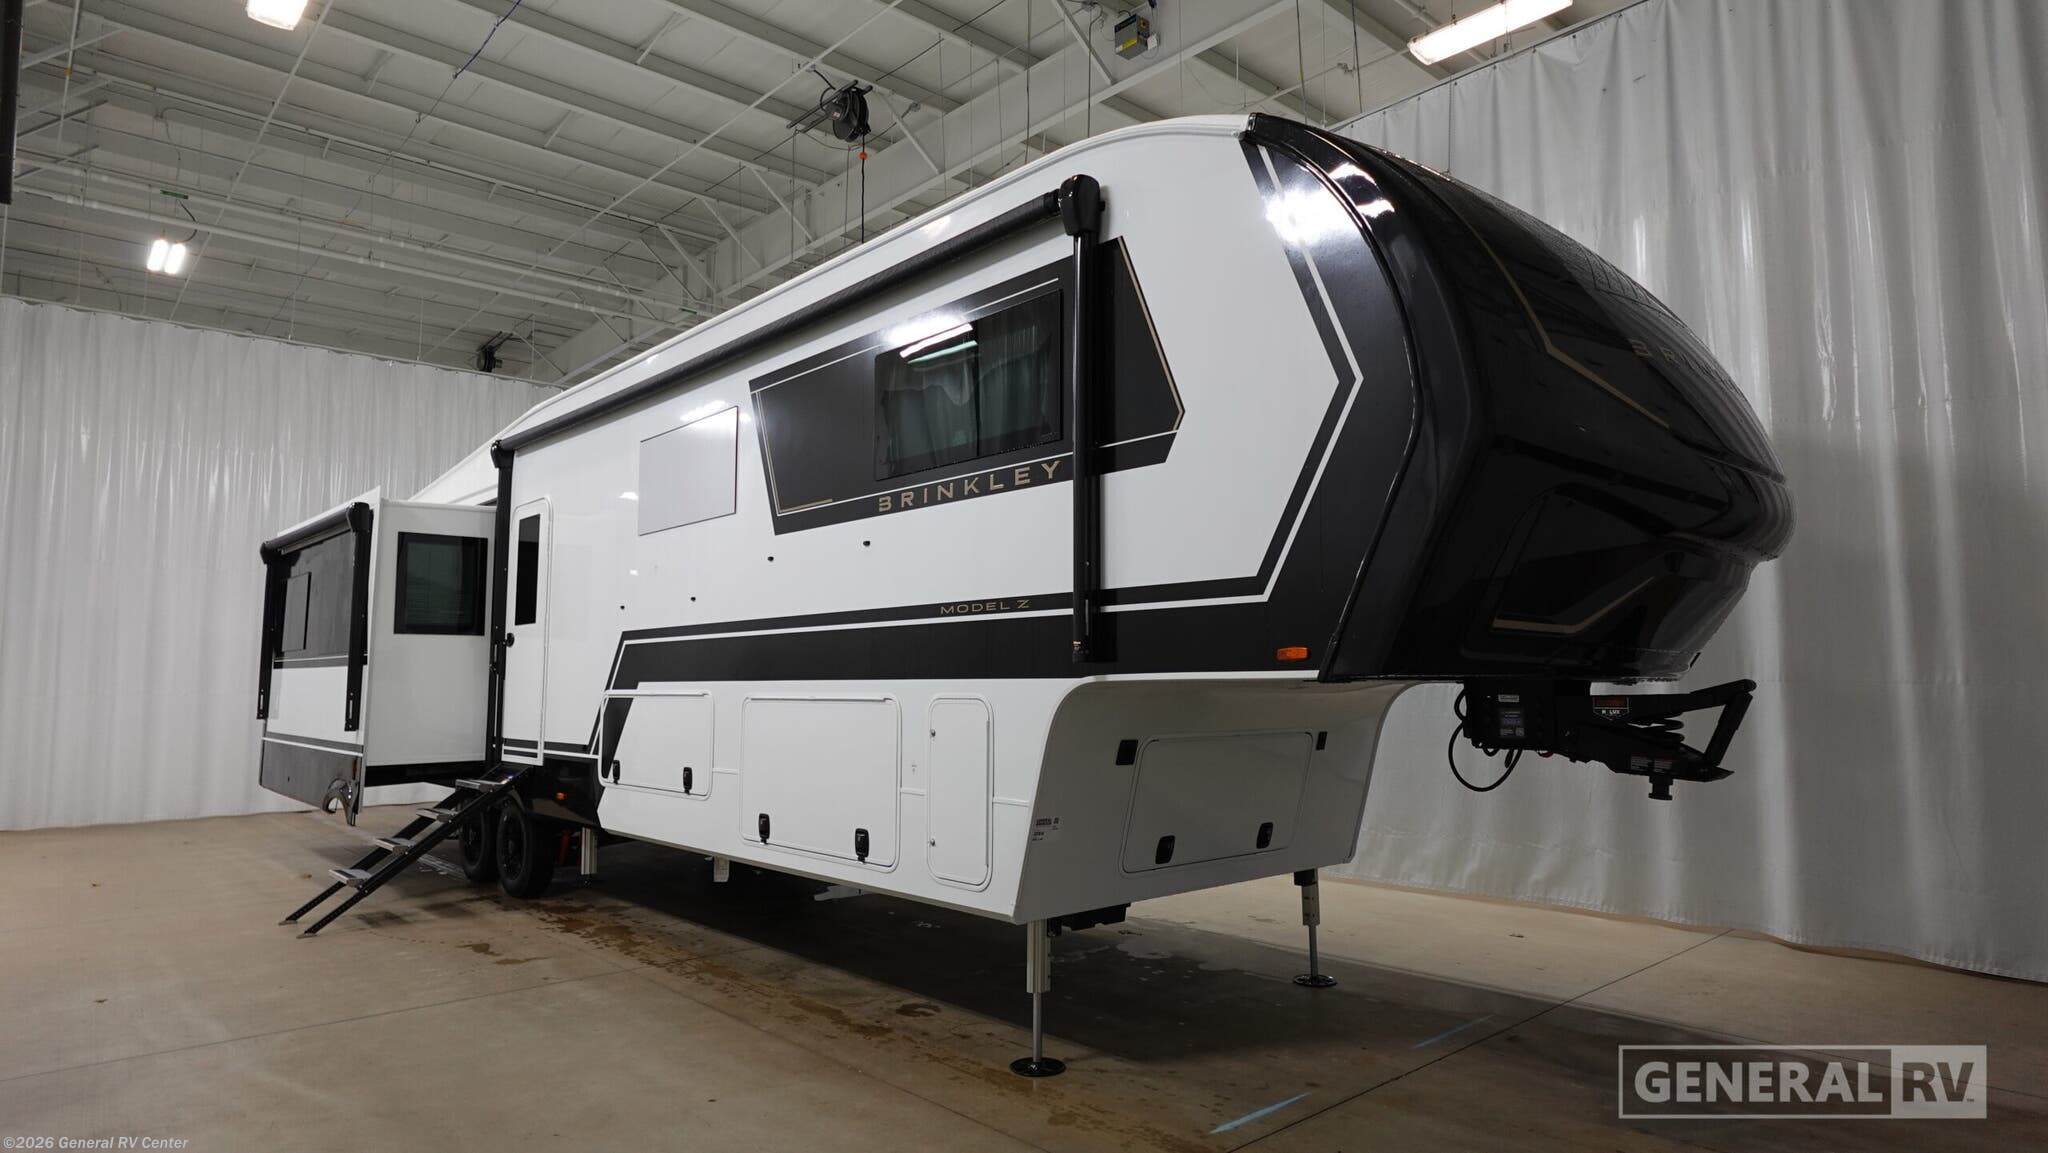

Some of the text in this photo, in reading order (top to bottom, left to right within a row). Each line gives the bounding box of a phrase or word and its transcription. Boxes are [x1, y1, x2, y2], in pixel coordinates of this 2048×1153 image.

[878, 460, 1061, 512] BRINKLEY
[940, 600, 1030, 615] MODEL Z
